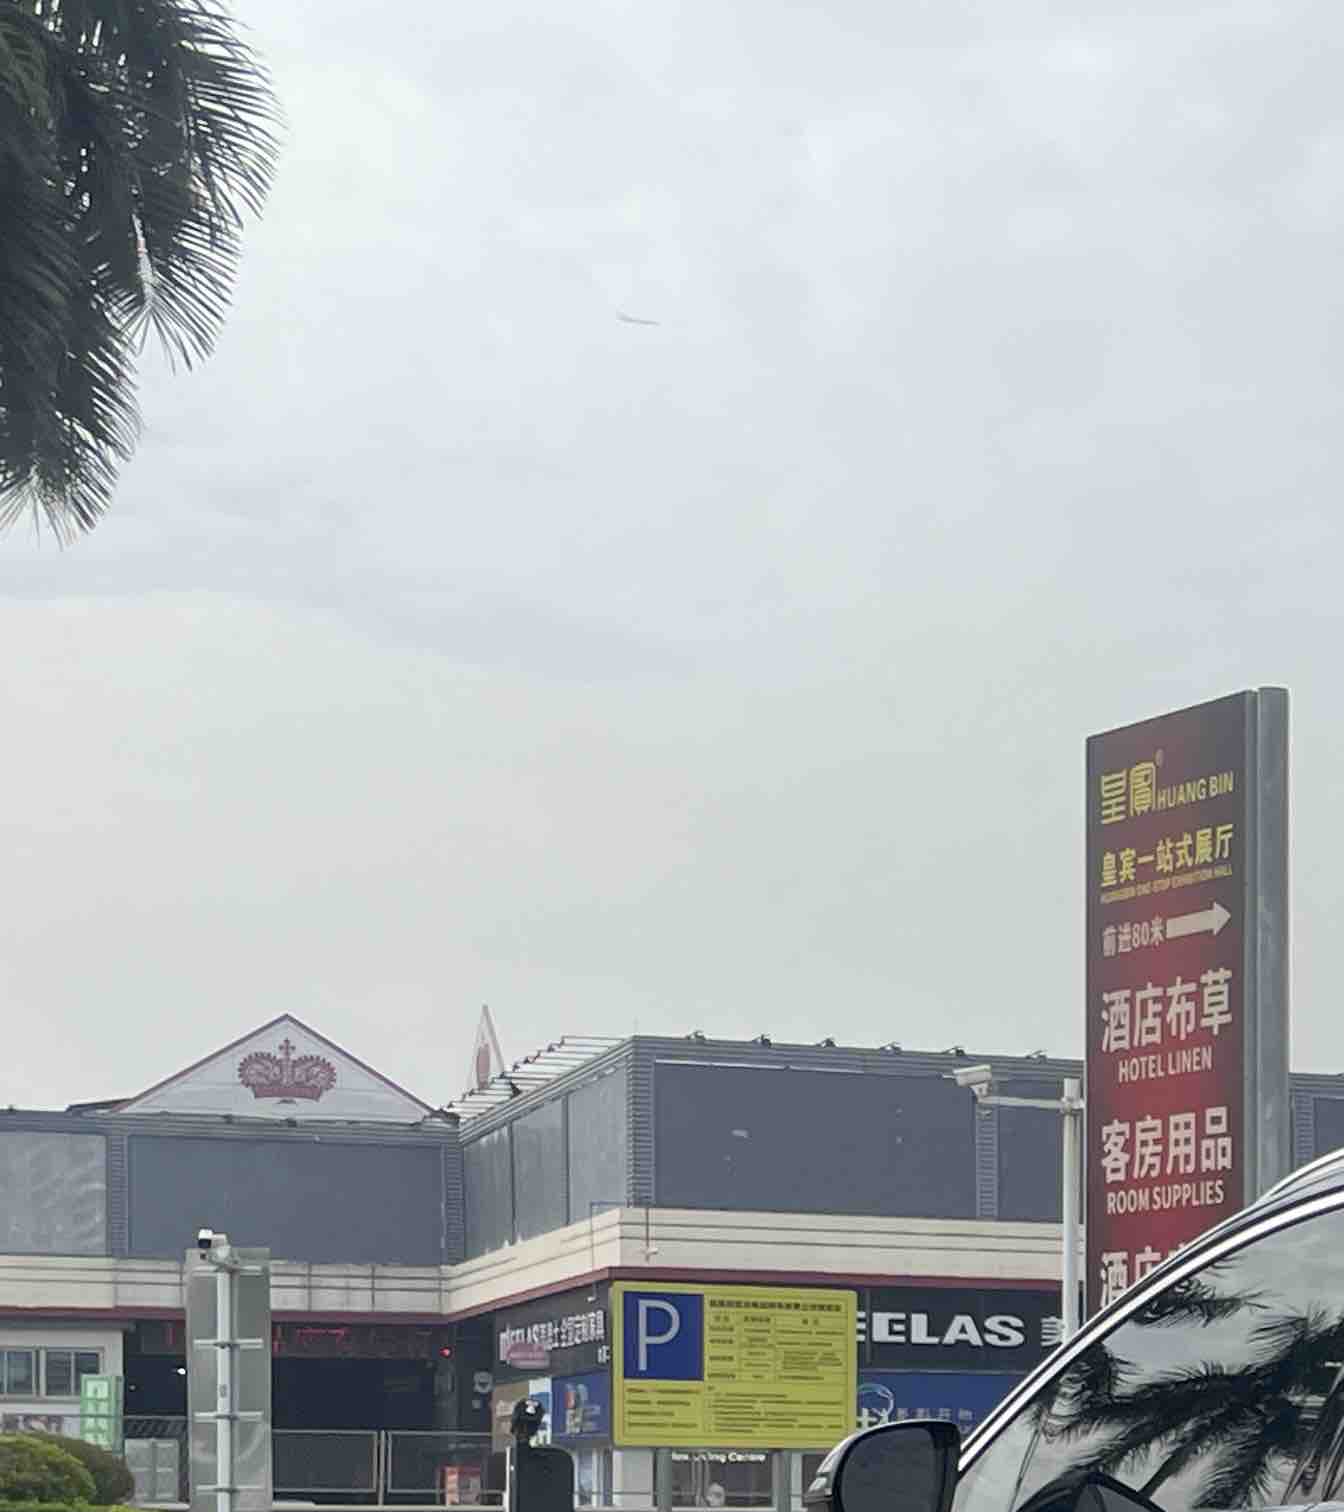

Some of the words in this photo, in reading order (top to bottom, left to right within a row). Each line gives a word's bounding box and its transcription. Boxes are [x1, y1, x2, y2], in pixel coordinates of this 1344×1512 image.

[1156, 777, 1207, 811] HUANG
[1208, 770, 1235, 797] BIN
[1100, 823, 1234, 888] 皇宾一站式展厅
[1101, 966, 1234, 1053] 酒店布草
[1118, 1055, 1166, 1083] HOTEL
[1167, 1045, 1213, 1076] LINEN
[1100, 1105, 1233, 1185] 客房用品
[1106, 1187, 1150, 1215] ROOM
[1151, 1179, 1225, 1212] SUPPLIES
[637, 1299, 681, 1372] P
